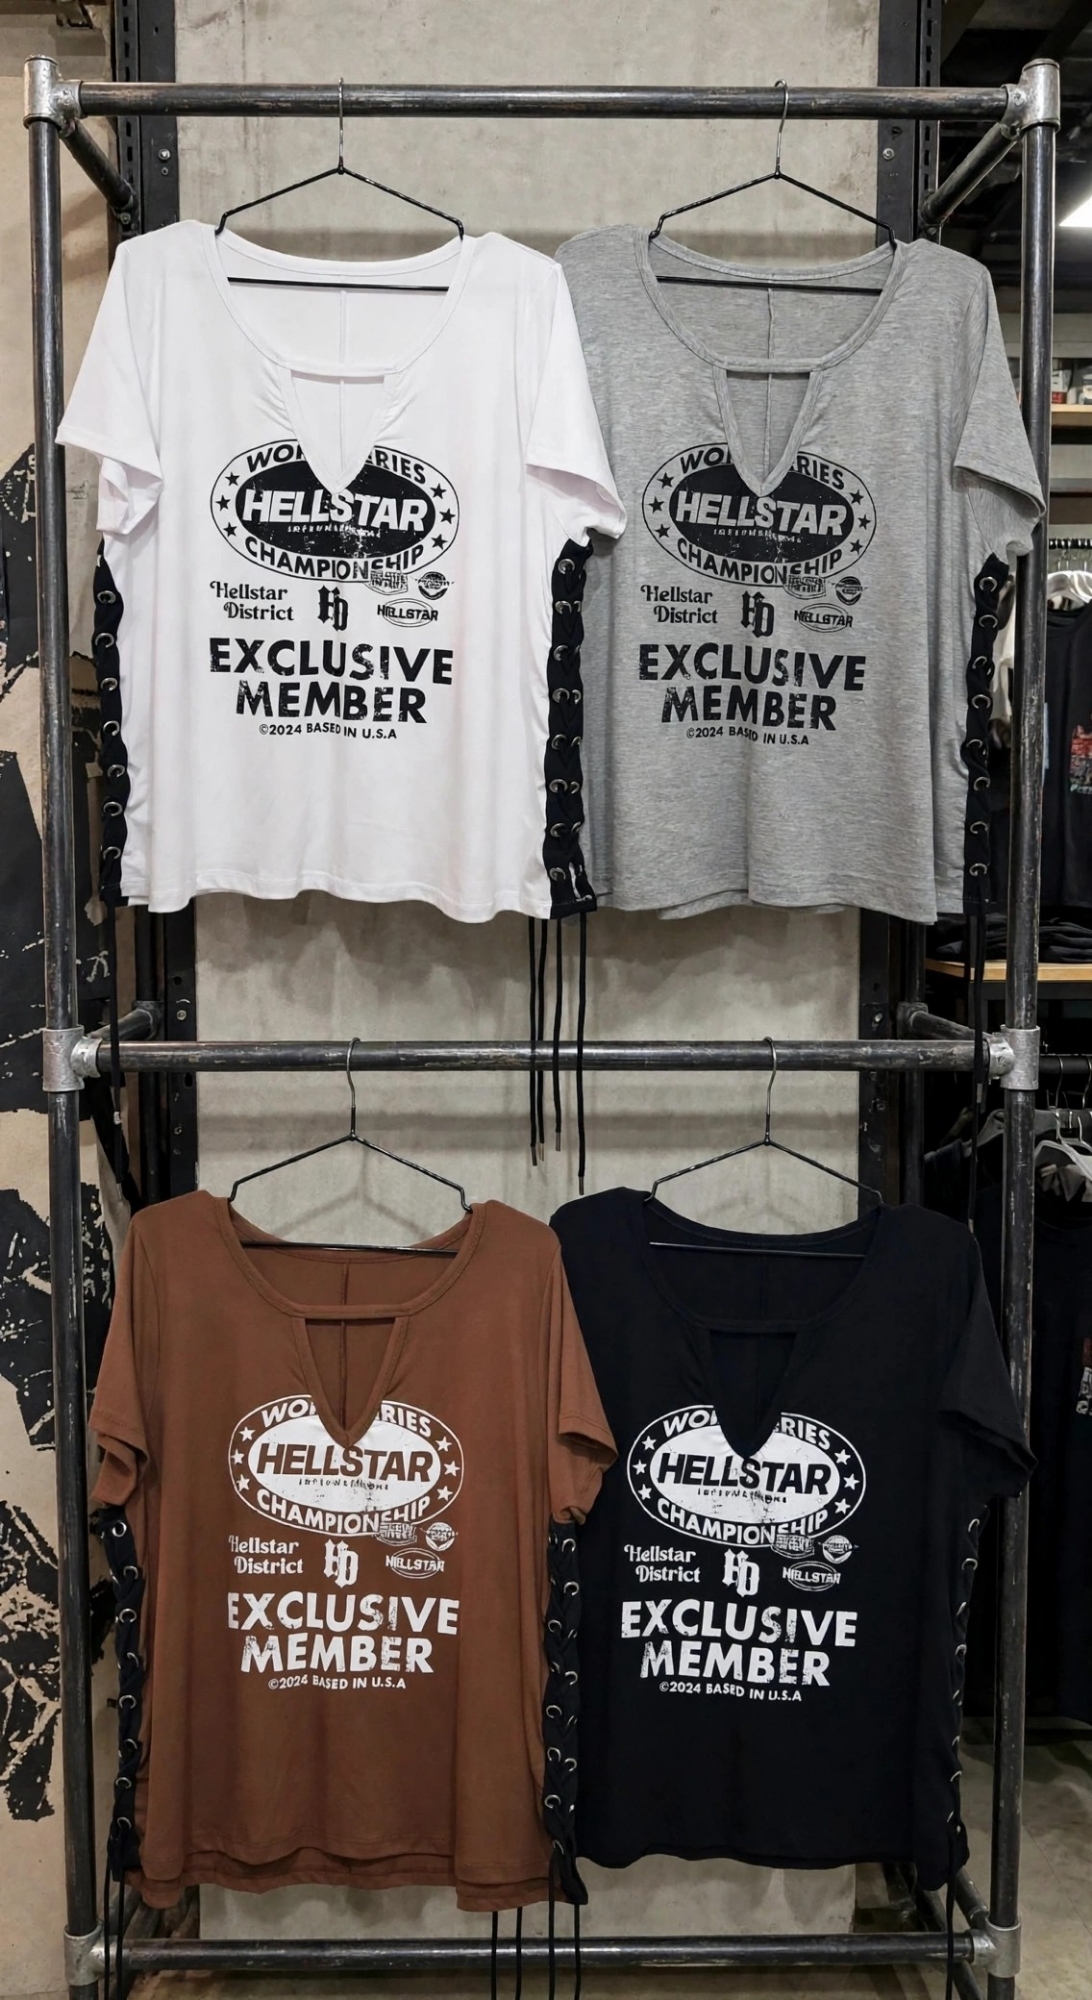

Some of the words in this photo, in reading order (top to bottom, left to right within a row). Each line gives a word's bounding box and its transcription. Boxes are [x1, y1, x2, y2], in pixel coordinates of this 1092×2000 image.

[242, 488, 428, 531] HELLSTAR
[675, 490, 847, 536] HELLSTAR
[210, 580, 288, 600] Hellstar
[640, 584, 713, 604] Hellstar
[224, 603, 294, 621] District
[653, 605, 718, 624] District
[209, 637, 454, 685] EXCLUSIVE
[639, 642, 866, 691] EXCLUSIVE
[235, 679, 427, 724] MEMBER
[661, 685, 836, 731] MEMBER
[306, 722, 341, 735] BASED
[343, 726, 357, 738] IN
[763, 732, 775, 744] IN
[256, 1443, 433, 1482] HELLSTAR
[657, 1453, 831, 1495] HELLSTAR
[228, 1535, 299, 1555] Hellstar
[624, 1544, 696, 1563] Hellstar
[234, 1555, 303, 1575] District
[635, 1565, 700, 1583] District
[228, 1591, 459, 1635] EXCLUSIVE
[621, 1599, 857, 1647] EXCLUSIVE
[241, 1632, 433, 1673] MEMBER
[640, 1640, 830, 1687] MEMBER
[312, 1674, 348, 1690] BASED
[353, 1677, 367, 1689] IN
[706, 1683, 744, 1697] BASED
[749, 1688, 764, 1700] IN
